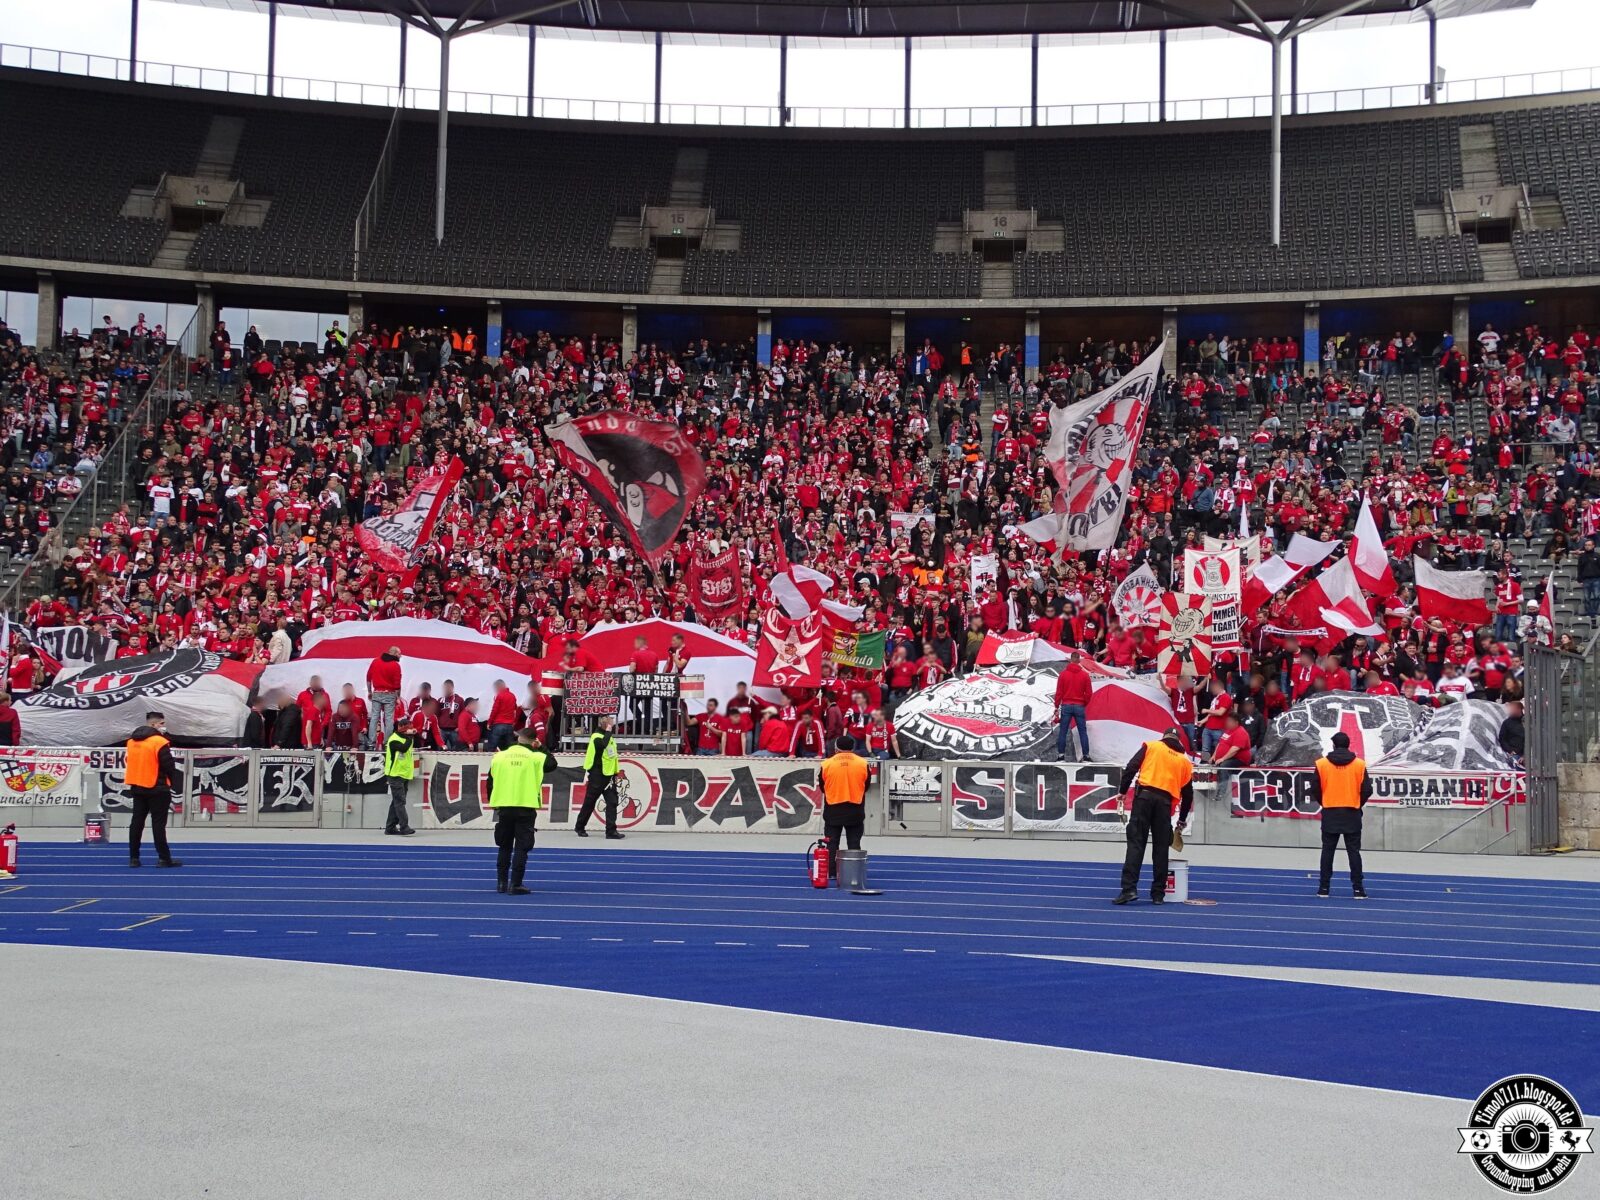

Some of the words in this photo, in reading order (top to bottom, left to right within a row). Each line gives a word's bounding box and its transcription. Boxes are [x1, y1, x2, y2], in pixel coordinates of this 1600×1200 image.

[195, 185, 210, 196] 14
[1477, 195, 1493, 206] 17
[671, 213, 684, 224] 15
[993, 216, 1007, 227] 16
[1213, 606, 1236, 620] MMER
[1213, 632, 1238, 642] NNSTATT
[821, 651, 874, 666] ommando
[635, 674, 650, 683] DU
[653, 674, 676, 683] BIST
[772, 672, 800, 686] 97
[635, 682, 676, 691] IMMER
[653, 690, 677, 698] UNS!
[0, 793, 79, 805] undelsheim
[1399, 798, 1452, 806] STUTTGART
